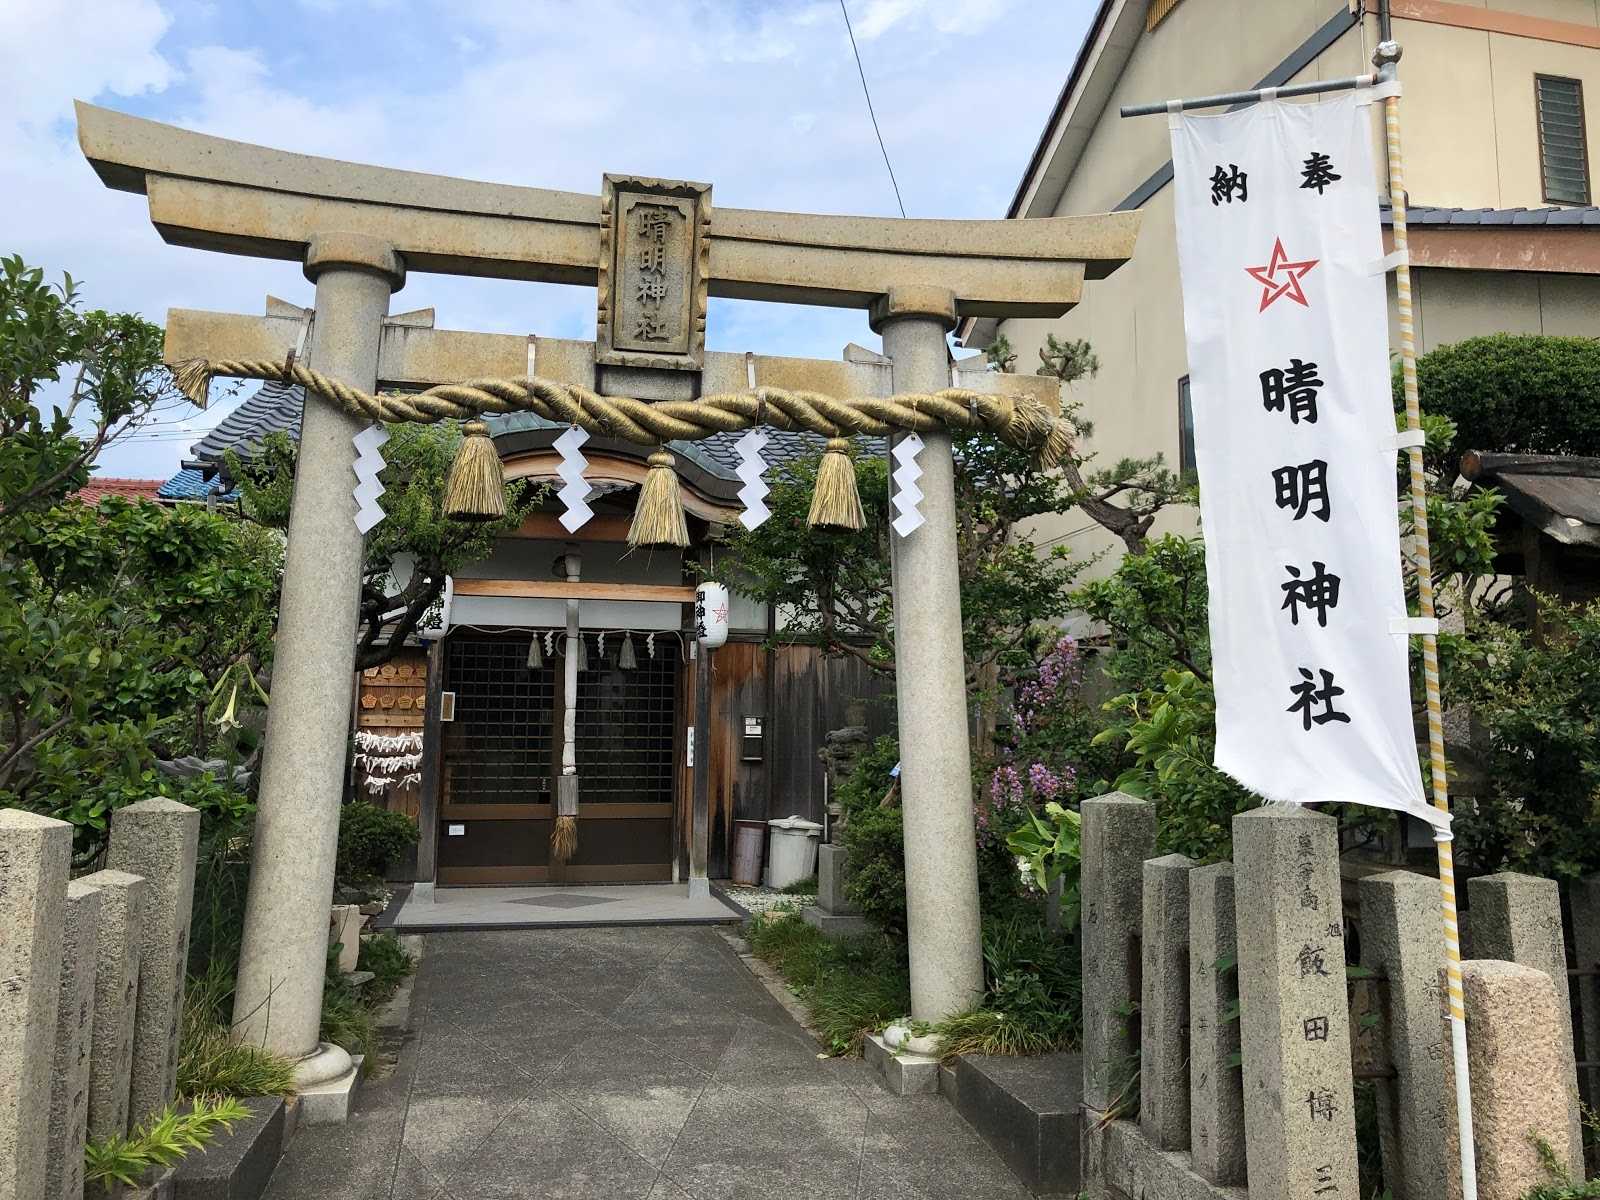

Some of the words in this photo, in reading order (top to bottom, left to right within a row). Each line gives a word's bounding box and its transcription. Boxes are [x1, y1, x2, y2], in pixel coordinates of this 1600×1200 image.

[634, 207, 672, 342] 晴明神社
[1259, 358, 1351, 731] 晴明神社
